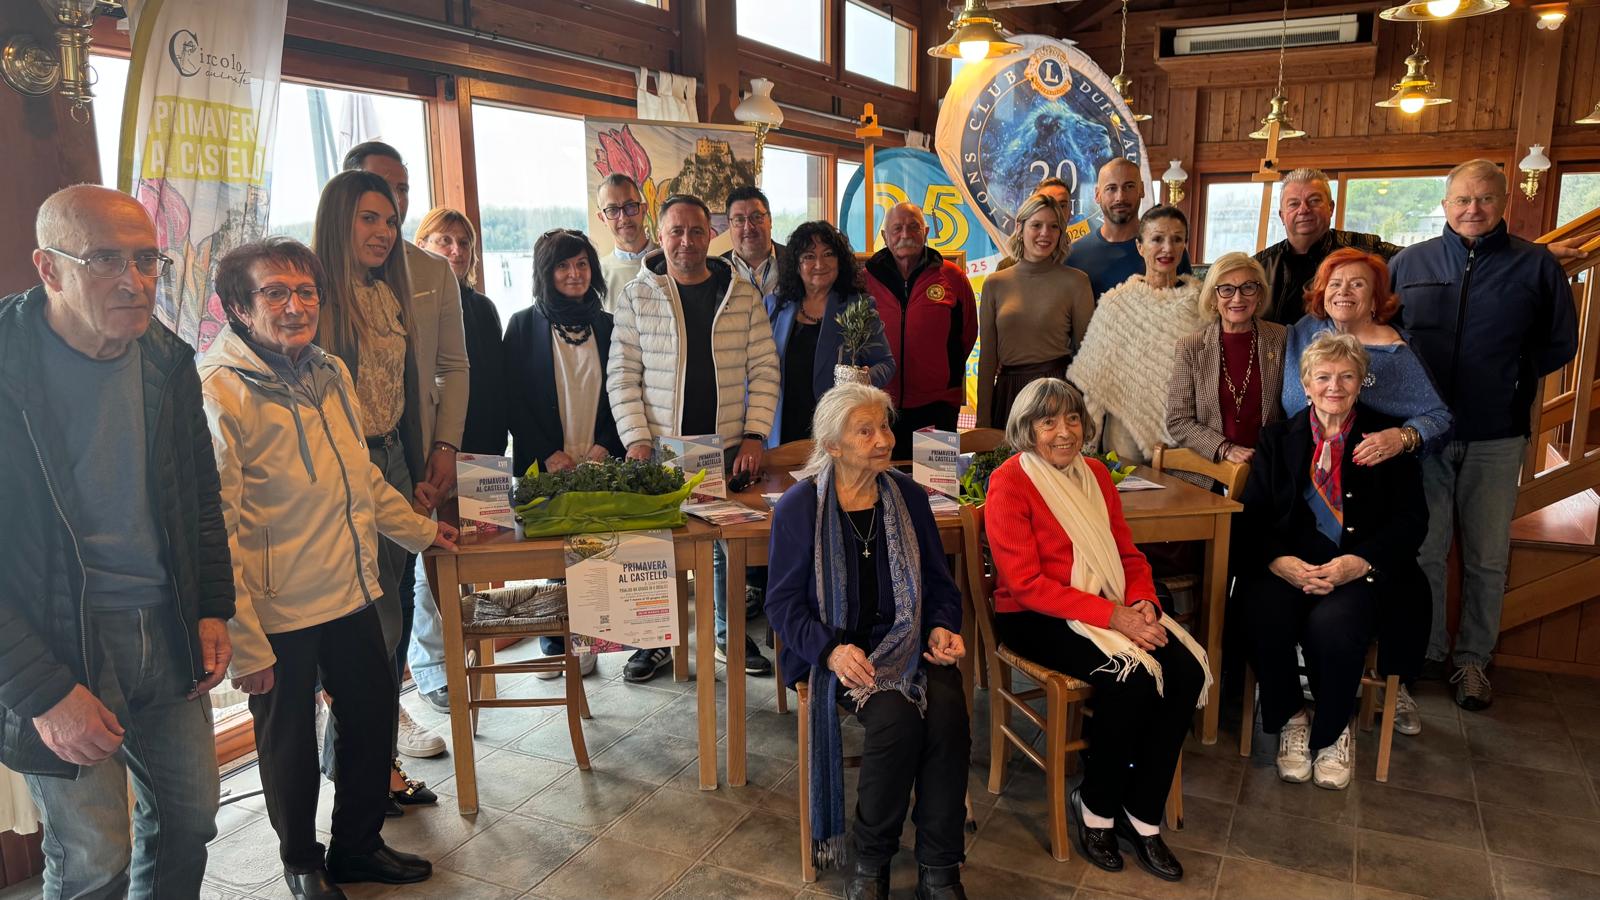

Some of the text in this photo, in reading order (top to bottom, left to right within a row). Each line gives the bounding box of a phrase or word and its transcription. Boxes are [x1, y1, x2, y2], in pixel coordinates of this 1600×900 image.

[169, 29, 242, 77] Circolo
[1044, 62, 1059, 84] L
[969, 70, 1017, 131] CLUB
[965, 152, 1010, 228] LIONS
[479, 476, 510, 486] PRIMAVERA
[484, 484, 510, 492] CASTELLO
[623, 559, 668, 573] PRIMAVERA
[618, 571, 668, 583] AL CASTELLO
